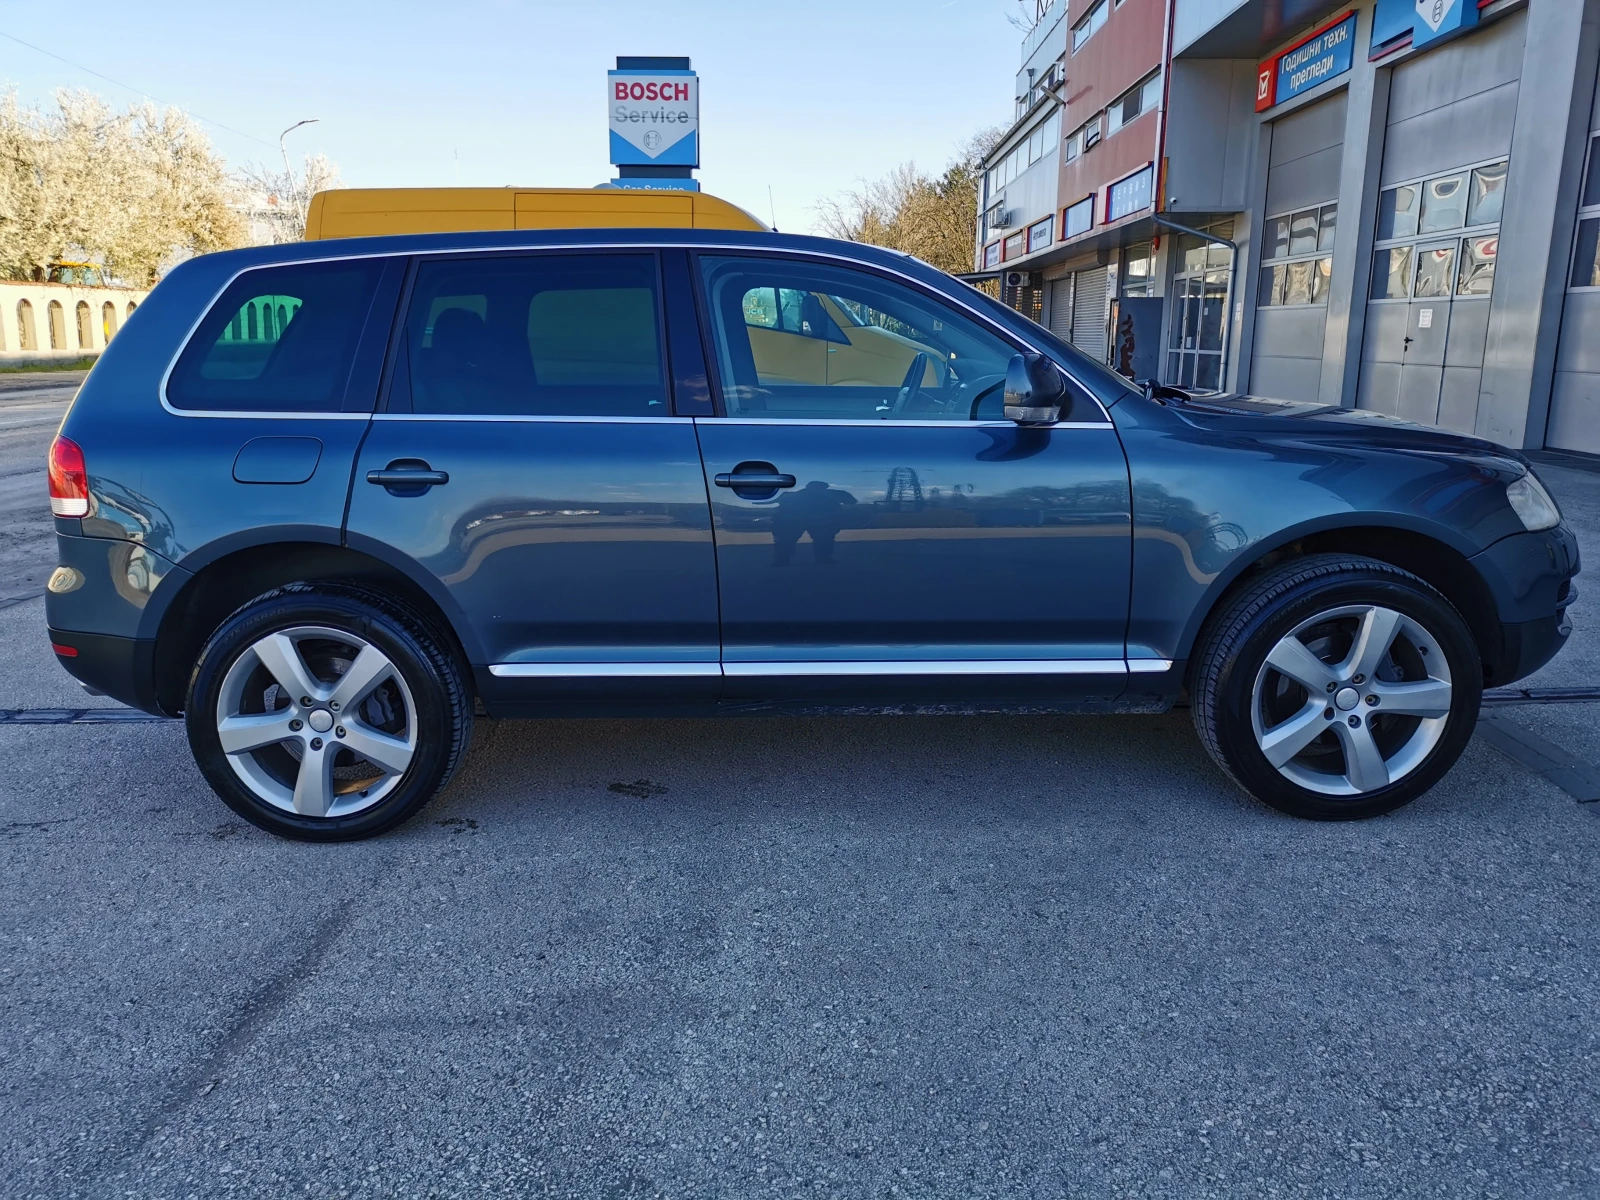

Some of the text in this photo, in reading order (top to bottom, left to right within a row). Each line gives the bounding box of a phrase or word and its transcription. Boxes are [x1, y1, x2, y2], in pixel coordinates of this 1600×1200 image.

[1281, 25, 1348, 74] Годишни техн.
[1290, 54, 1334, 91] прегледи
[615, 82, 689, 101] BOSCH
[615, 105, 689, 123] Service
